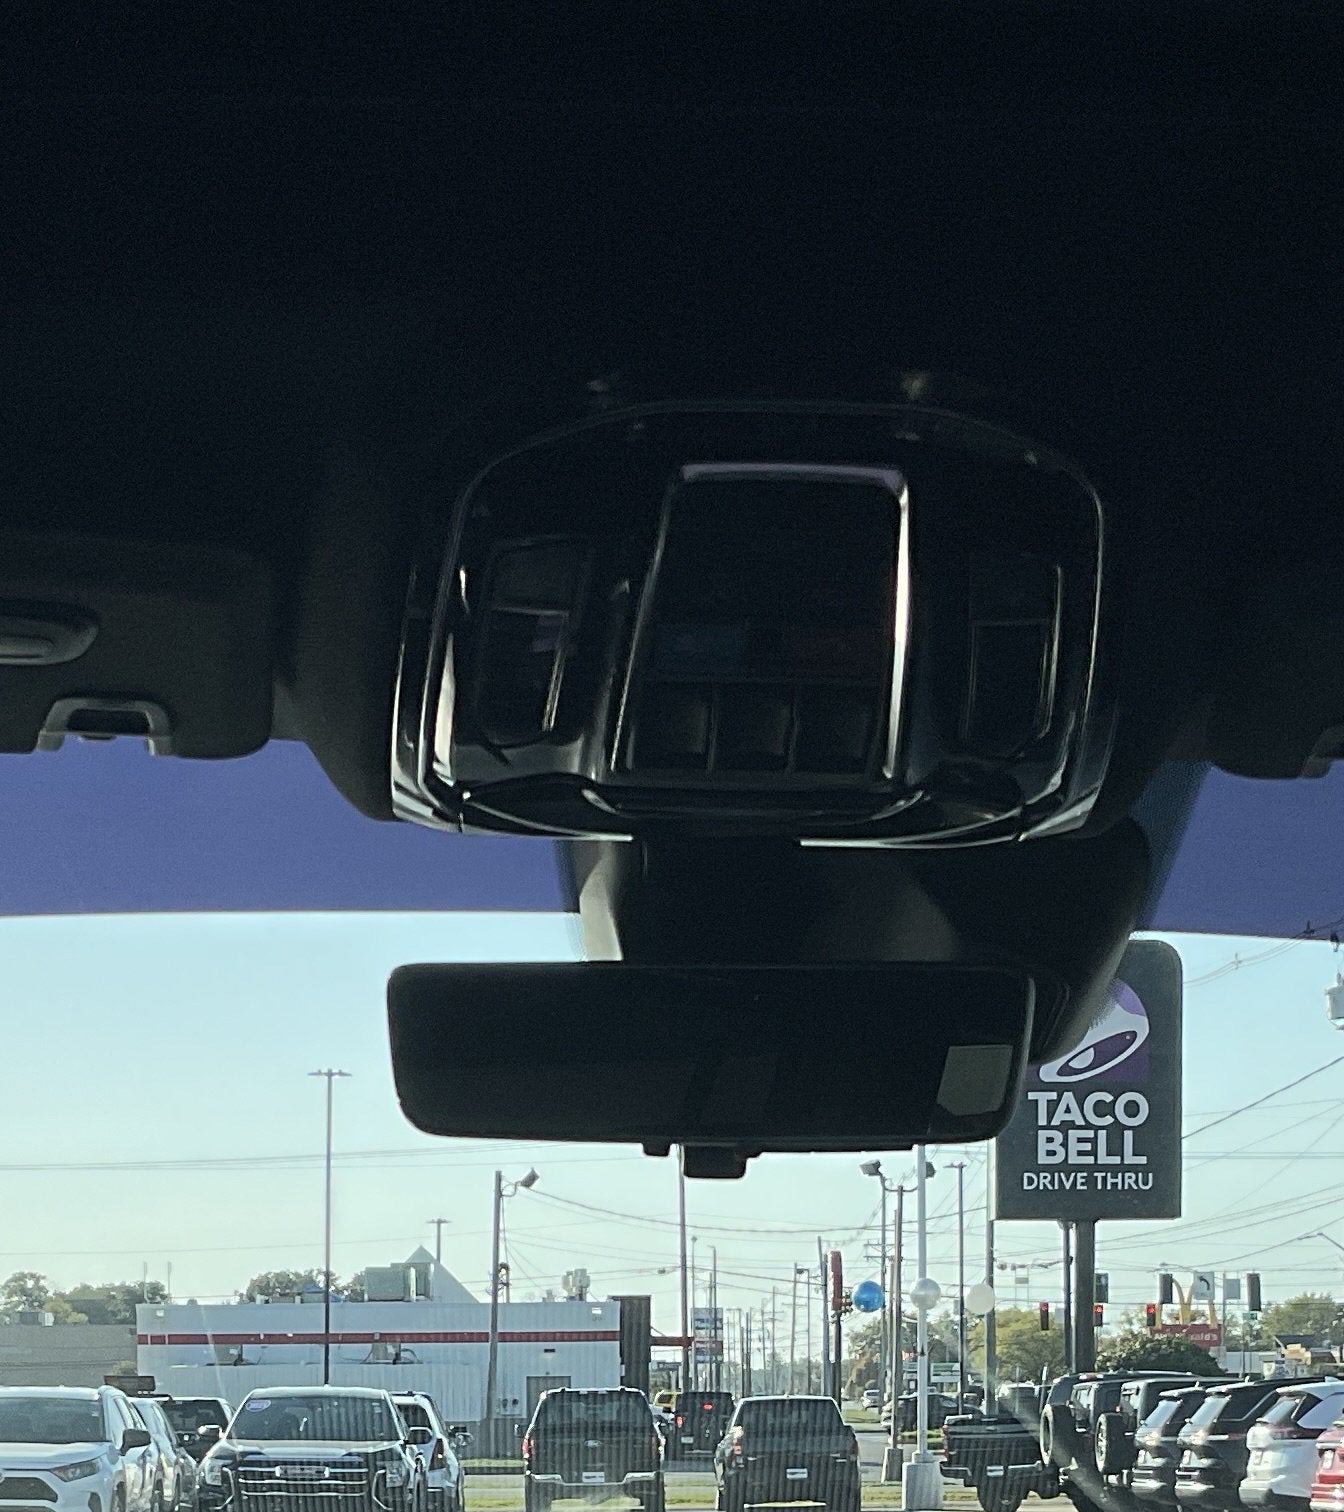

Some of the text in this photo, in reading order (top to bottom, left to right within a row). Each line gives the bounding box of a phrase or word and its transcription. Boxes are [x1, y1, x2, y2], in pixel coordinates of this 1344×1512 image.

[1027, 1091, 1149, 1127] TACO
[1036, 1130, 1148, 1165] BELL
[1023, 1172, 1153, 1190] DRIVE THRU
